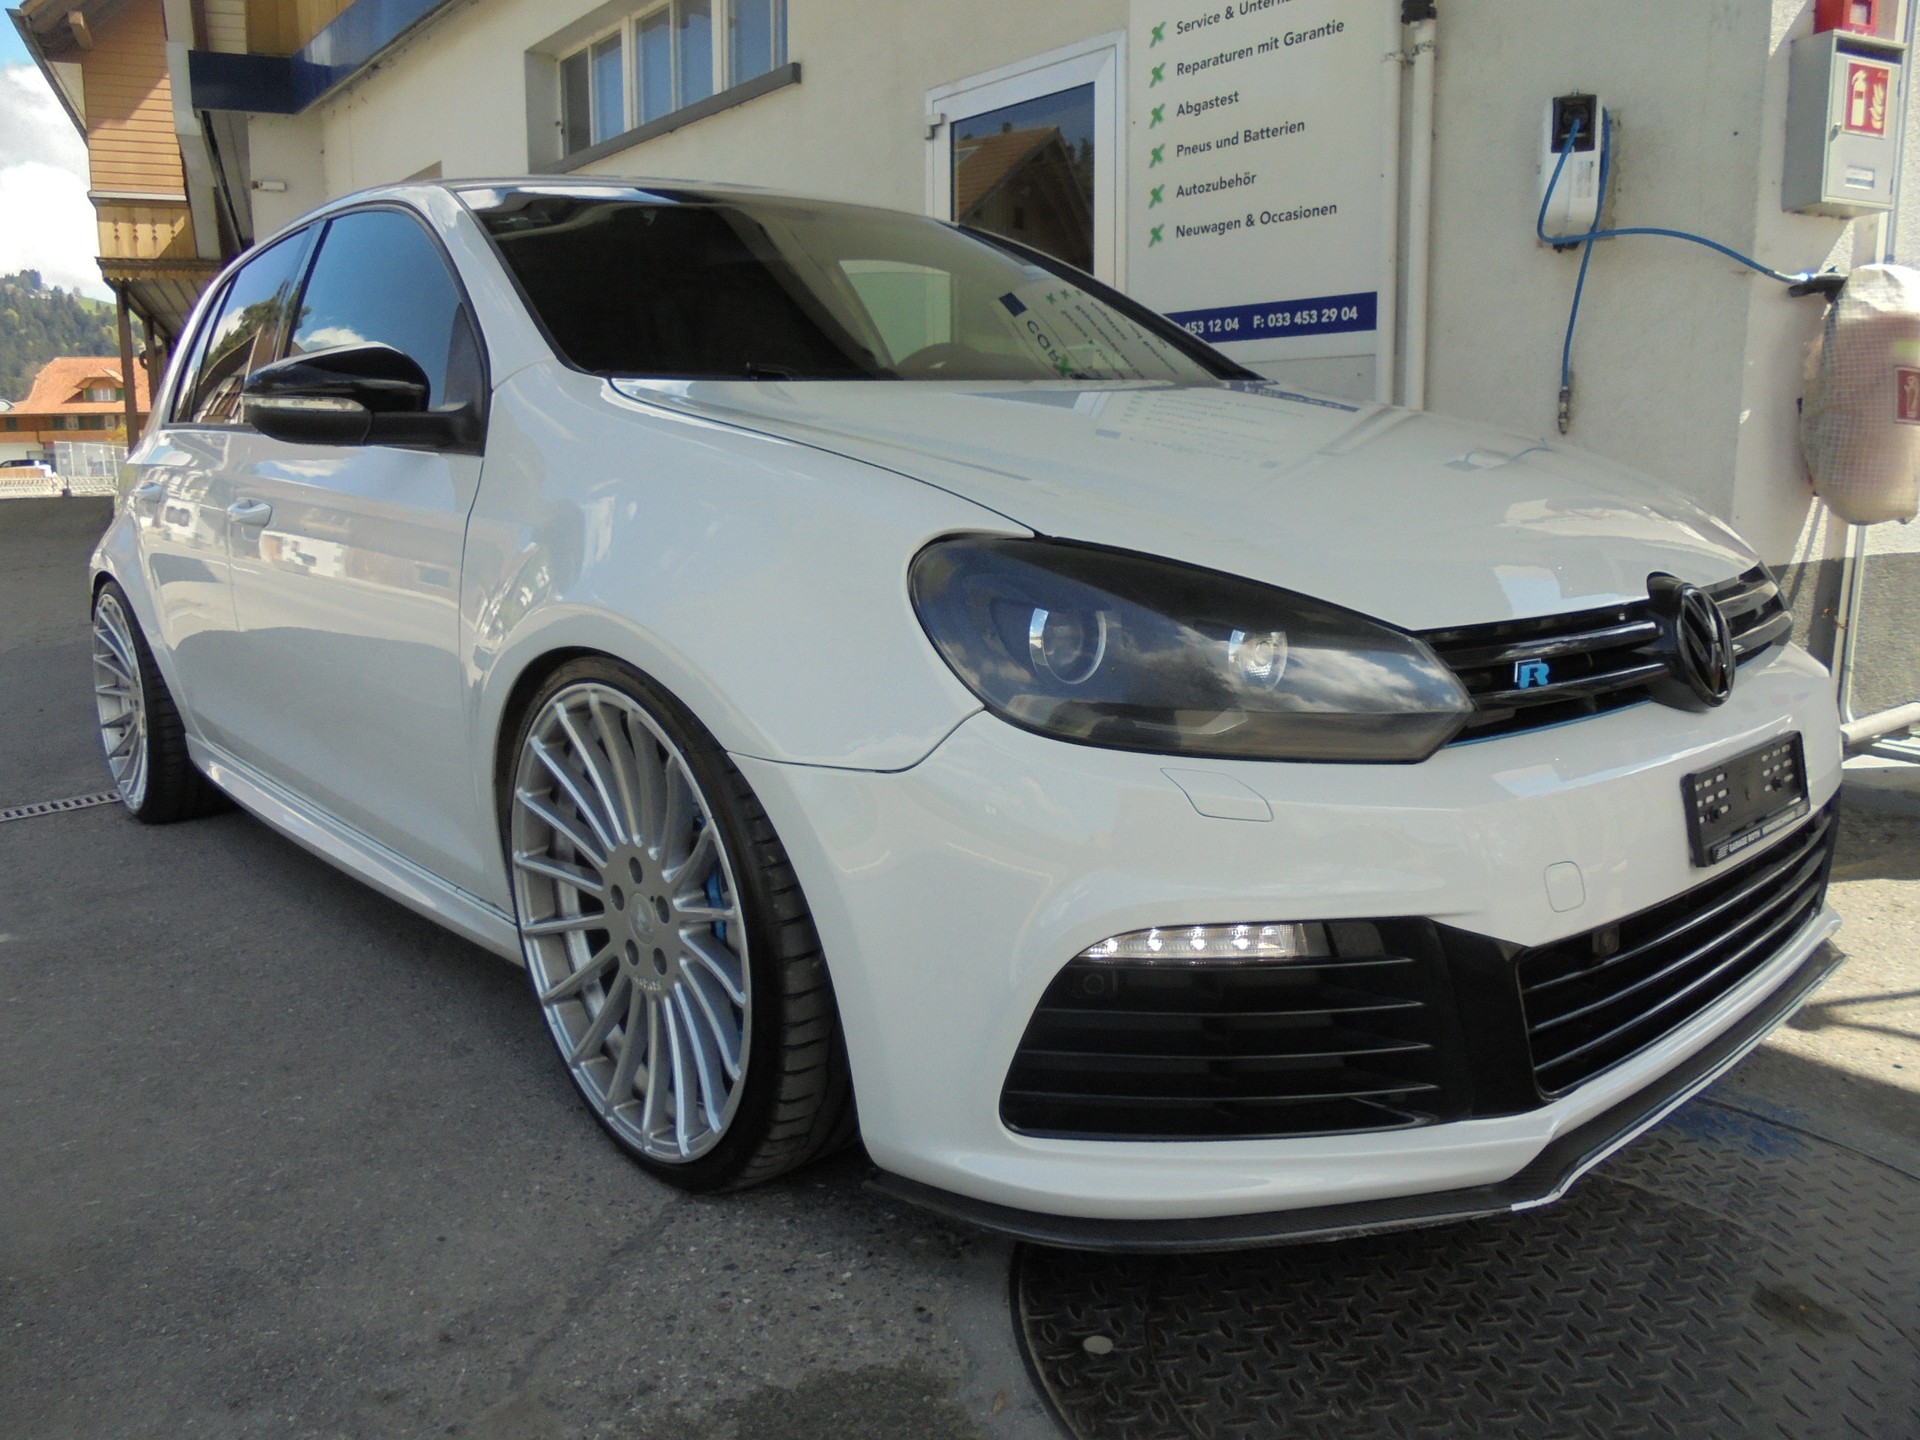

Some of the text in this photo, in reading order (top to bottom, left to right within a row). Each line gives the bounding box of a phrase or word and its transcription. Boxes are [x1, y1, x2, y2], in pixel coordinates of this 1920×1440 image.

[1176, 11, 1221, 35] Service
[1225, 6, 1234, 20] &
[1177, 20, 1345, 76] Reparaturen mit Garantie
[1176, 91, 1239, 117] Abgastest
[1176, 120, 1305, 157] Pneus und Batterien
[1176, 172, 1257, 198] Autozubehör
[1176, 203, 1338, 238] Neuwagen & Occasionen
[1184, 317, 1240, 334] 453 12 04
[1253, 306, 1358, 329] F: 033 453 29 04
[1518, 662, 1550, 689] R
